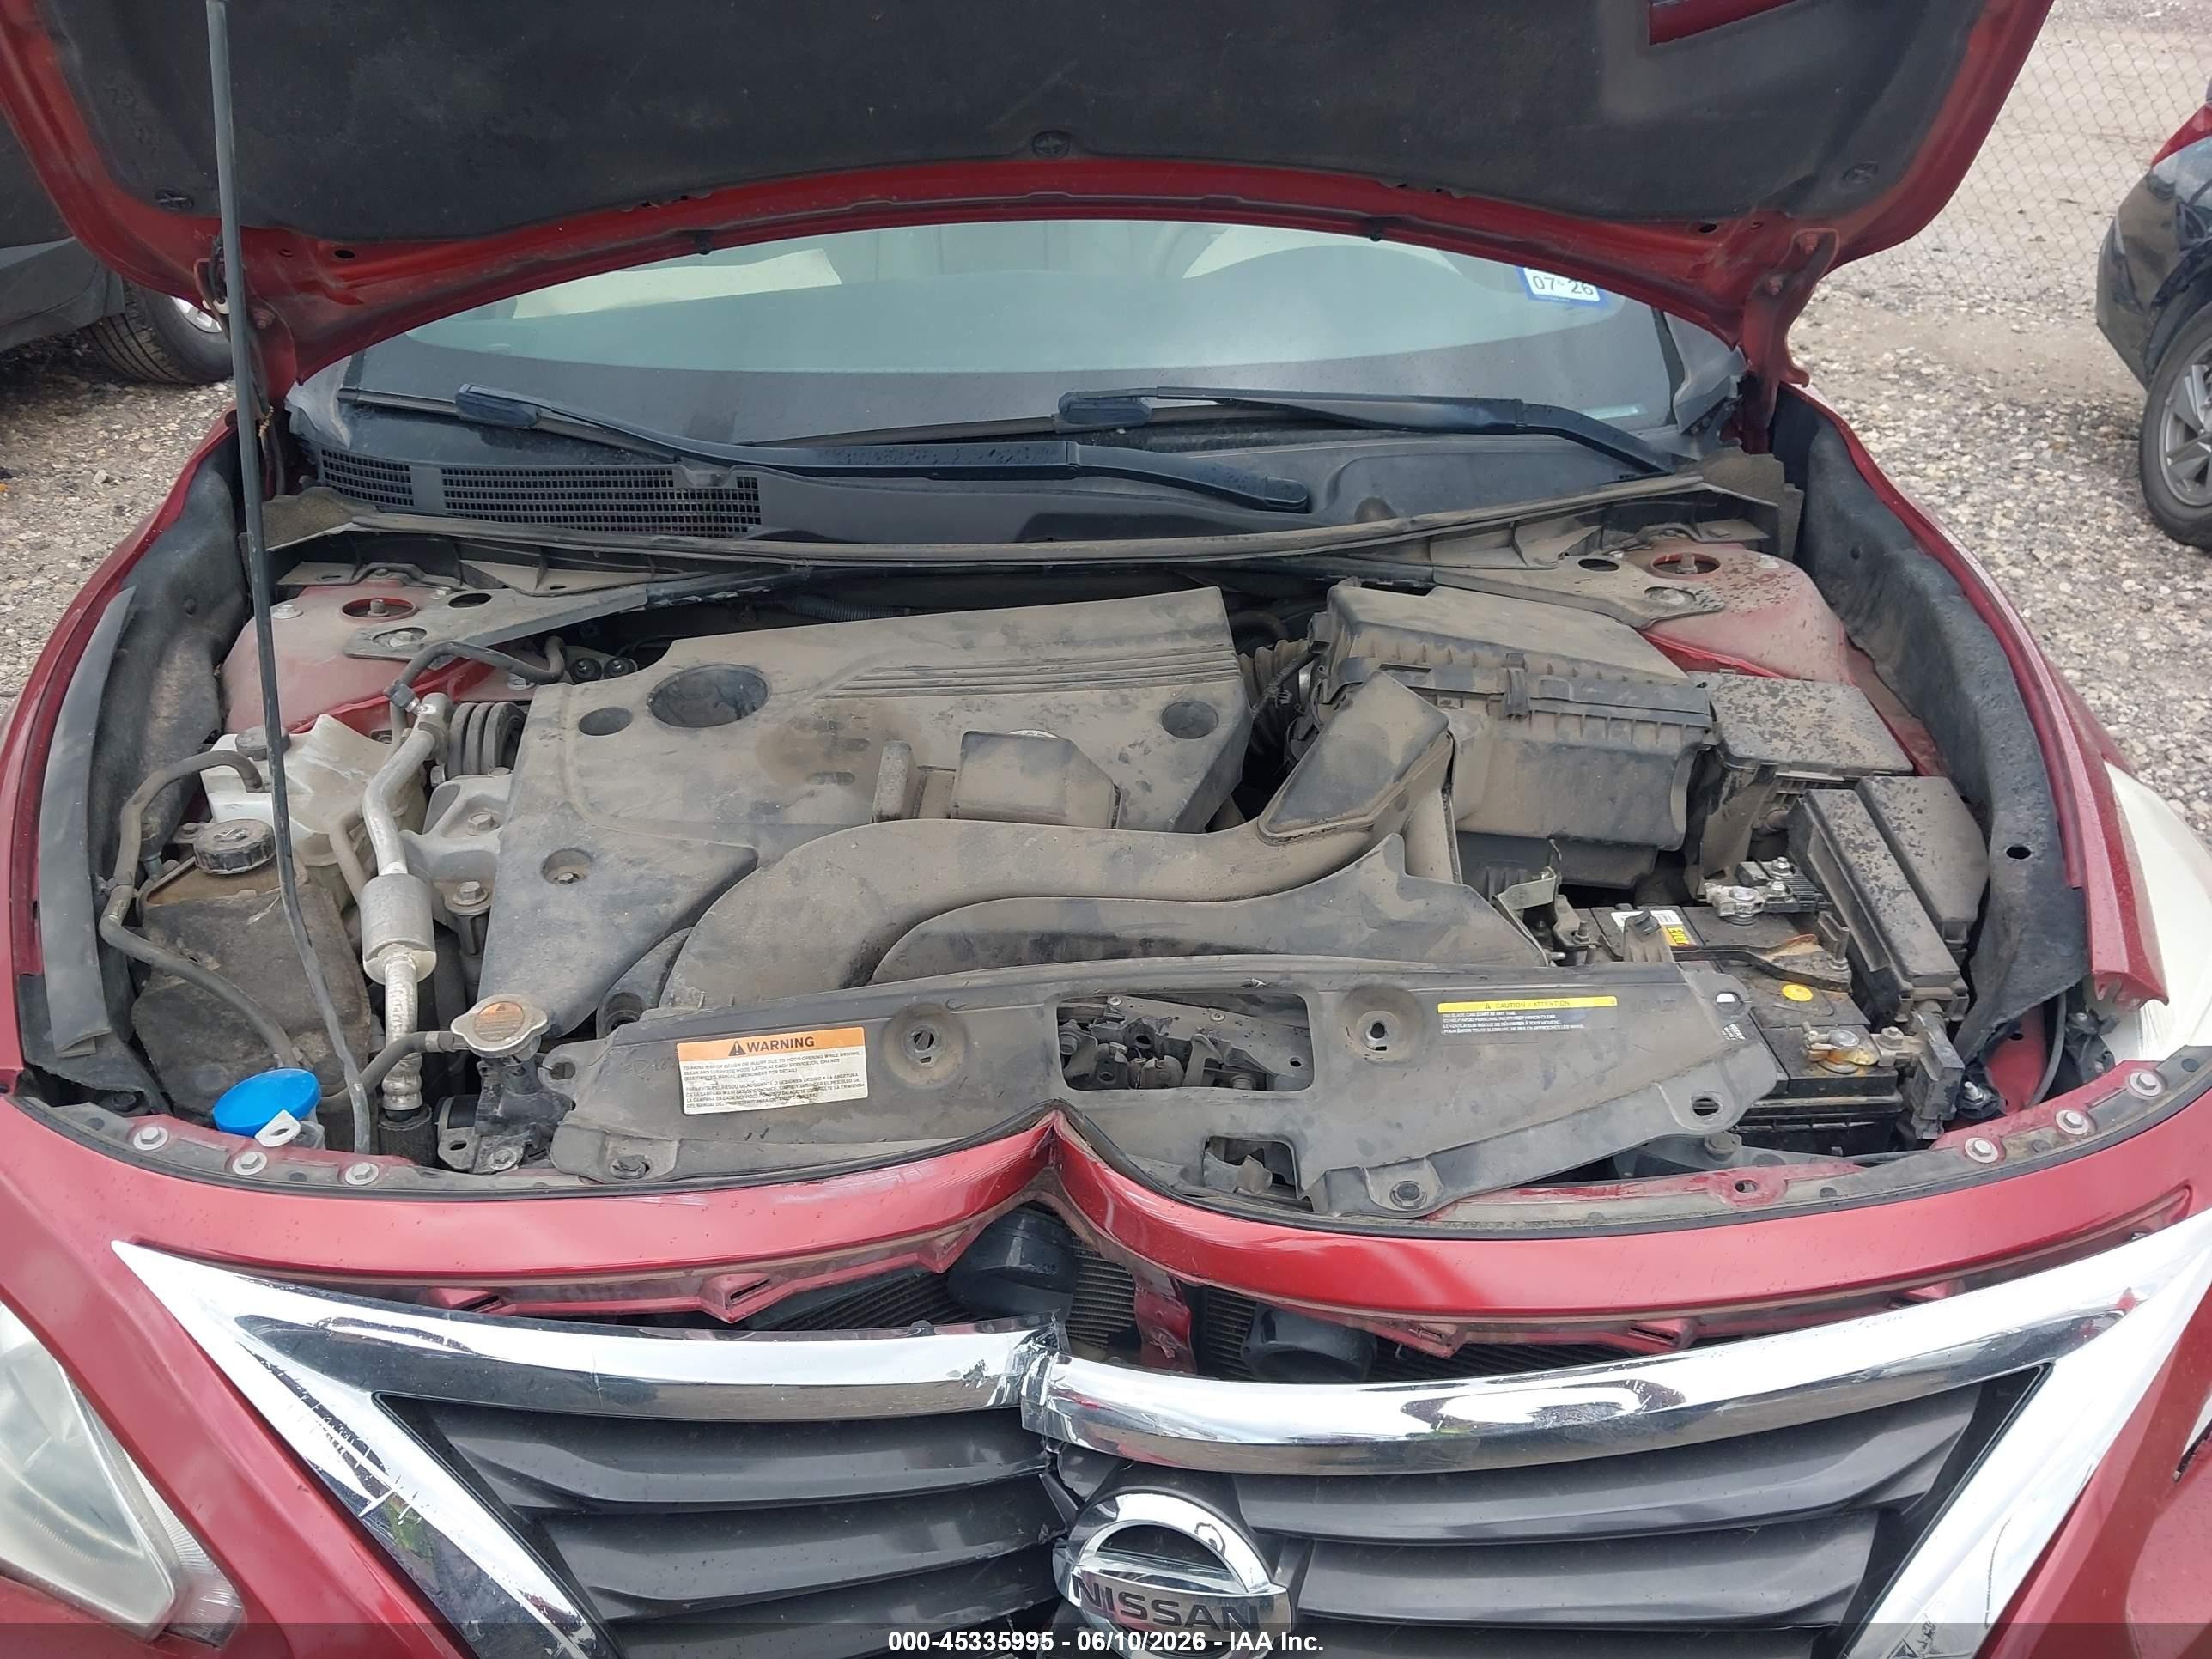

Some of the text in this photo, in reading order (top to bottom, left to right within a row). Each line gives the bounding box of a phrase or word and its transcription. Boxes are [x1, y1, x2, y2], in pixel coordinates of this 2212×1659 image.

[1533, 276, 1595, 296] 07 26
[746, 1036, 815, 1053] WARNING
[1072, 1574, 1261, 1632] NISSAN
